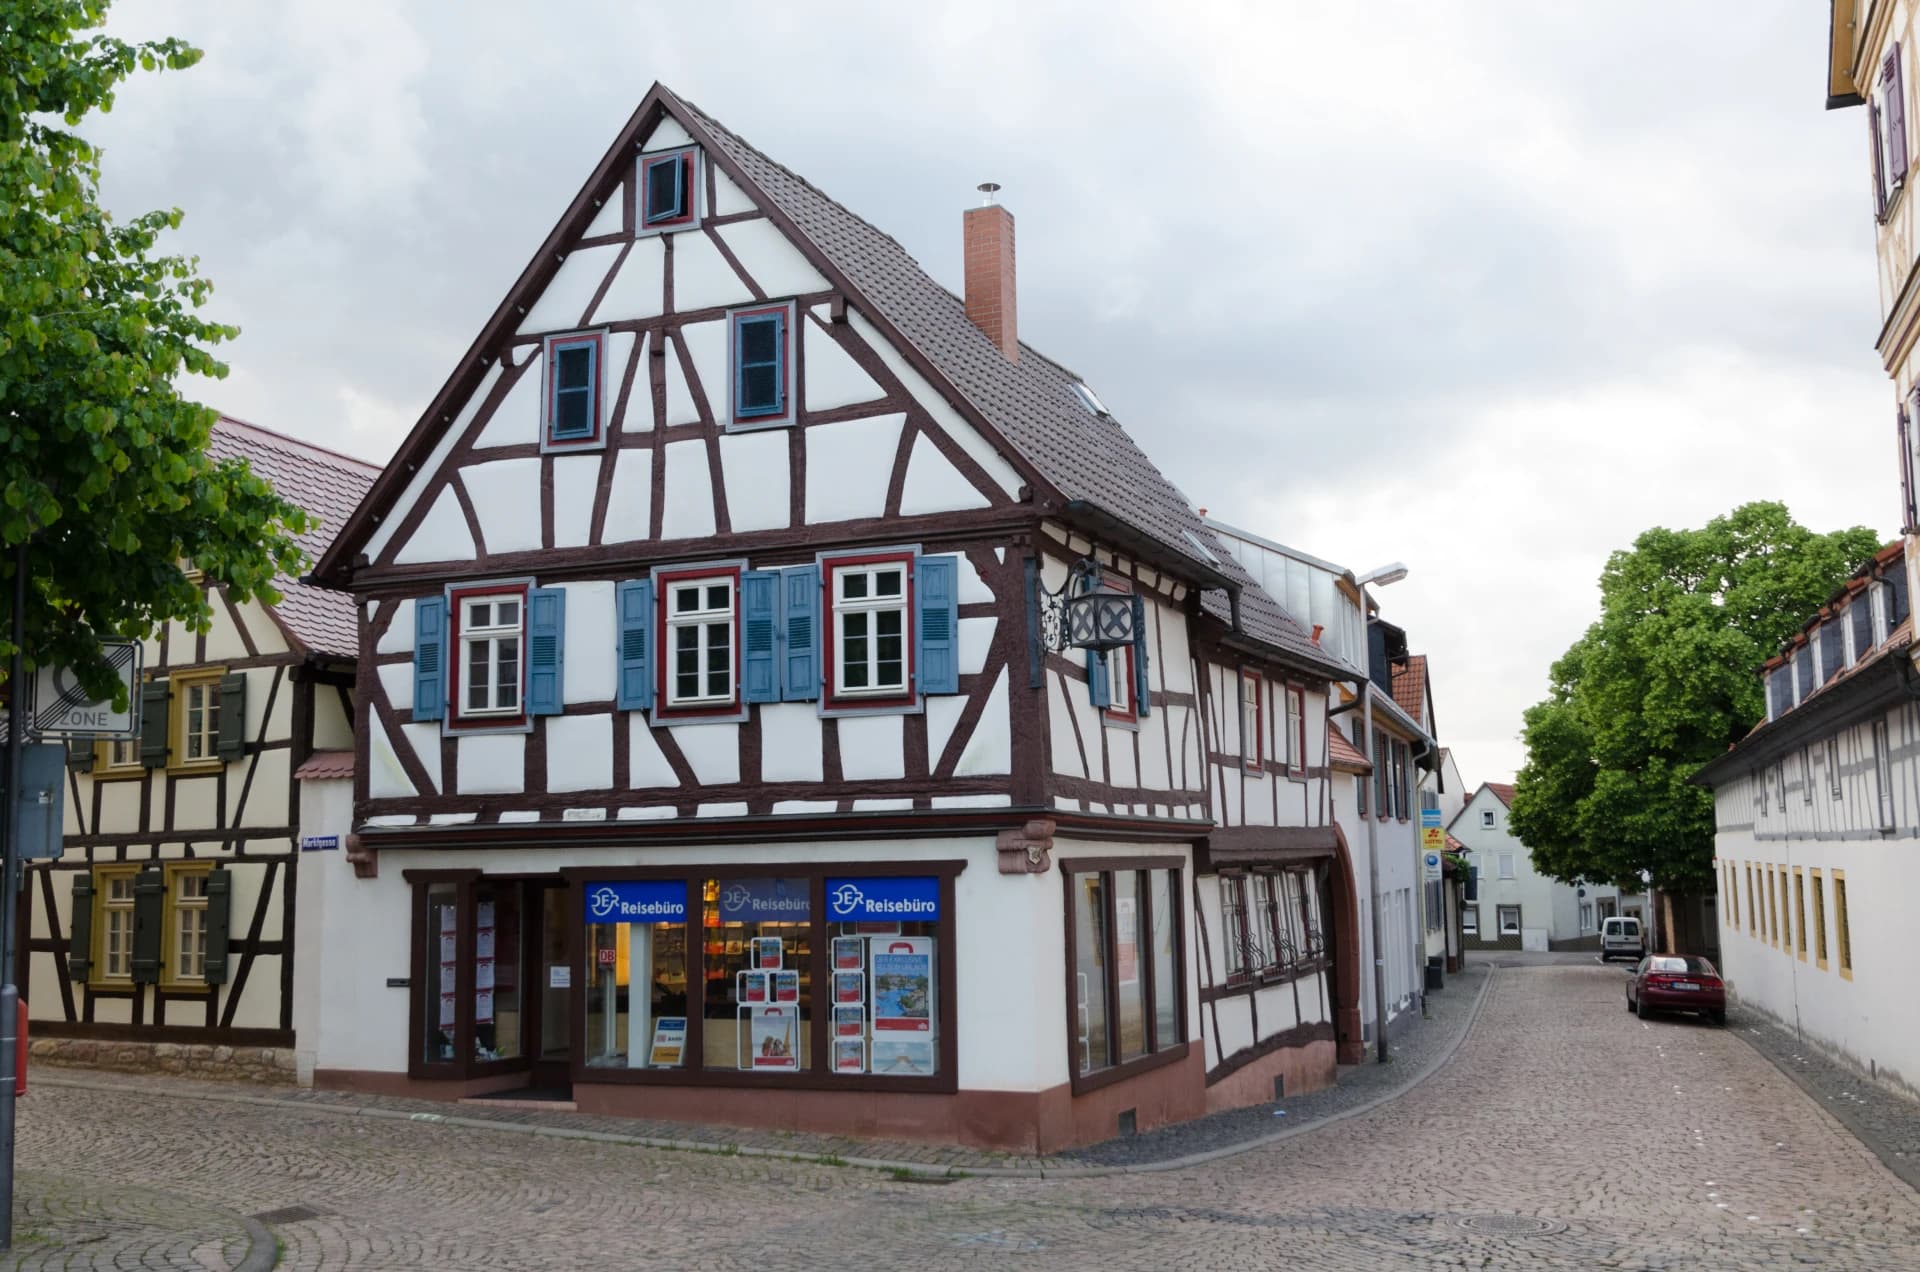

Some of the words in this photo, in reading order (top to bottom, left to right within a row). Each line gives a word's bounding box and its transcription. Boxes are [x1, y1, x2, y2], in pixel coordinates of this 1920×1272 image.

[59, 711, 109, 727] ZONE
[621, 901, 685, 915] Reisebüro
[865, 899, 936, 913] Reisebüro
[600, 950, 615, 961] DB
